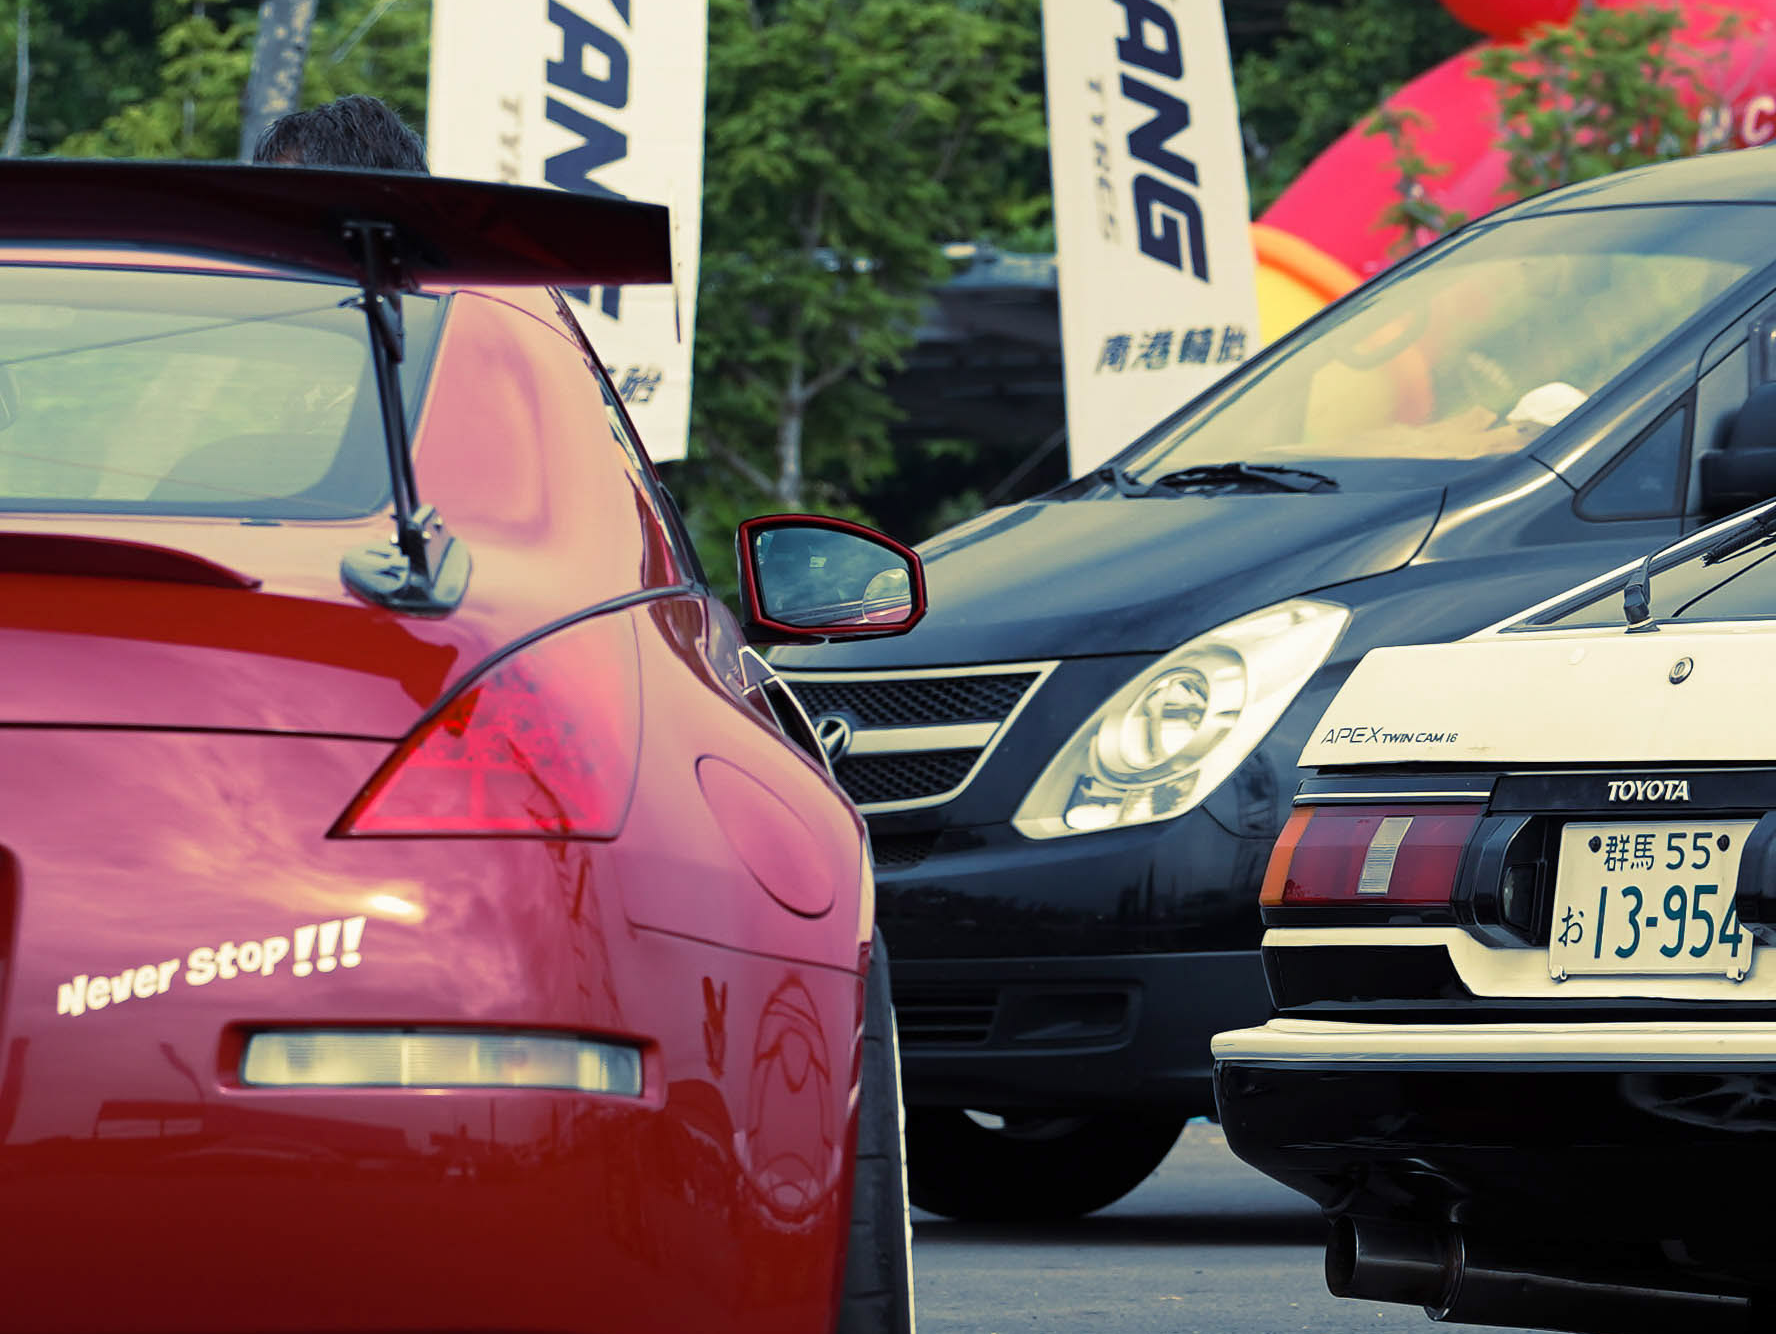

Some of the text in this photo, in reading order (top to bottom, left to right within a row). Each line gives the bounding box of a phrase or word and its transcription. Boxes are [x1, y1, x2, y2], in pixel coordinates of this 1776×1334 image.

[1321, 726, 1458, 744] APEX TWIN CAM 16
[1608, 780, 1691, 801] TOYOTA
[1604, 832, 1713, 871] 群馬 55
[1558, 885, 1743, 959] お 13-954
[57, 959, 181, 1017] Never
